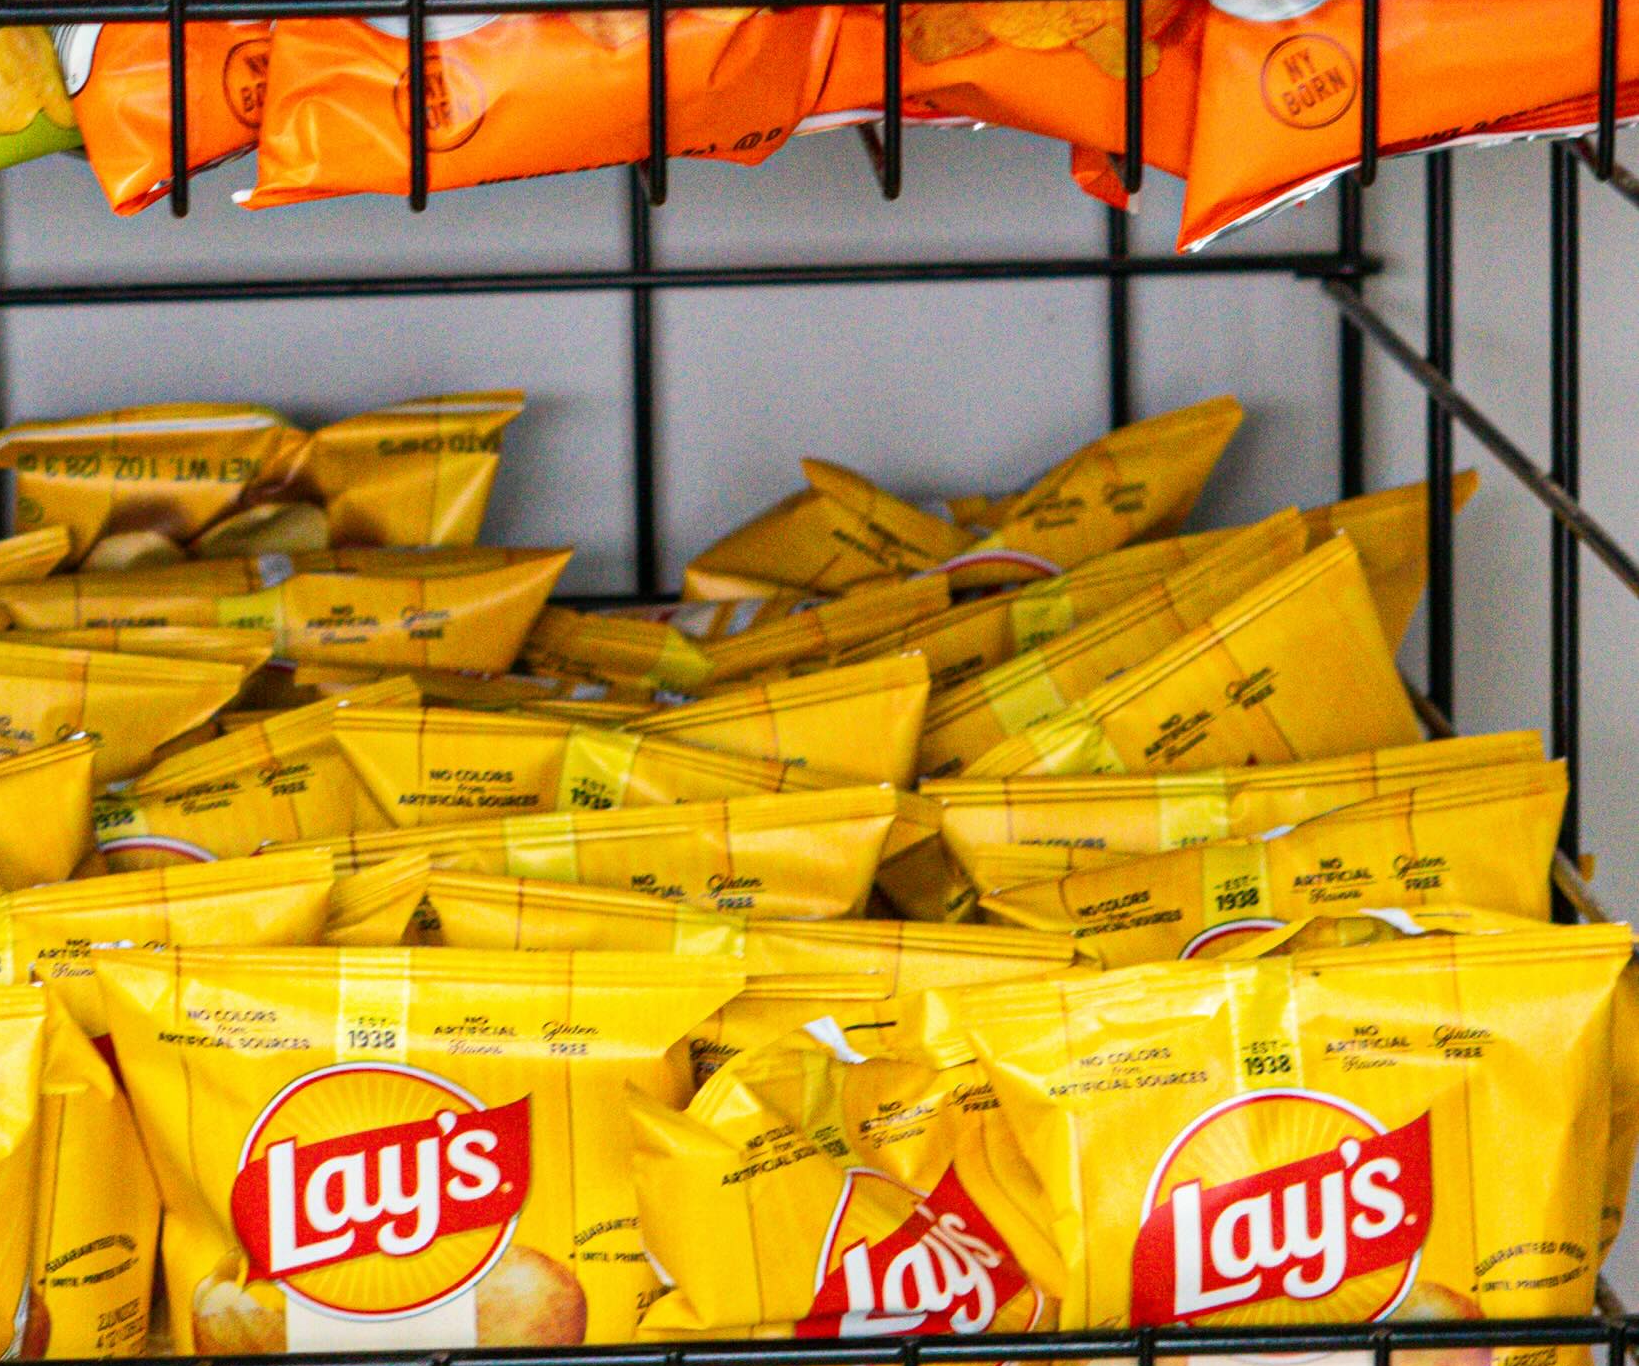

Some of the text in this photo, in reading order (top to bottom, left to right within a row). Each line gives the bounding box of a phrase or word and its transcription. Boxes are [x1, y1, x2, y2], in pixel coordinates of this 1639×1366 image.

[1285, 51, 1314, 82] NY
[1284, 71, 1349, 116] BORN
[1291, 867, 1373, 889] ARTIFICIAL
[1392, 853, 1447, 879] Gluten
[1214, 887, 1261, 912] 1938
[346, 1029, 397, 1049] 1938
[1431, 1023, 1492, 1047] Gluten
[1102, 1045, 1171, 1067] COLORS
[1243, 1054, 1293, 1076] 1938
[1047, 1070, 1209, 1098] ARTIFICIAL SOURCES
[266, 1109, 502, 1275] Lay's
[1170, 1138, 1406, 1317] Lay's
